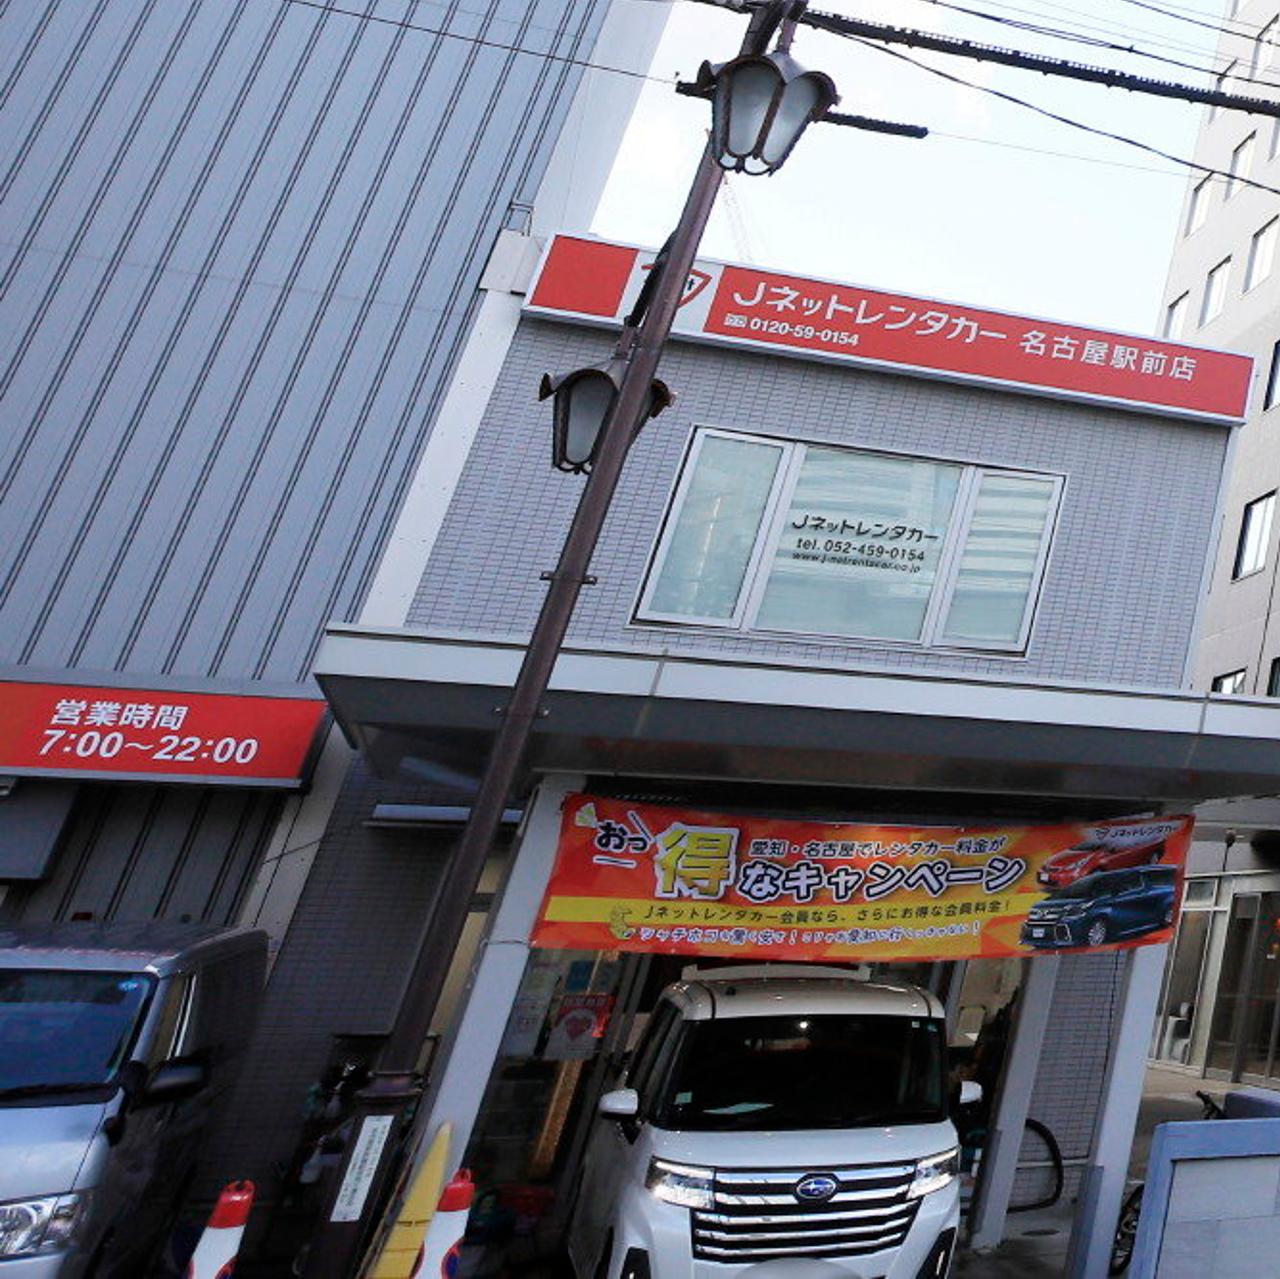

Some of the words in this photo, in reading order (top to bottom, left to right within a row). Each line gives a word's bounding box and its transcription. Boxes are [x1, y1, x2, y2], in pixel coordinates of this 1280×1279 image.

[732, 282, 1008, 344] Jネットレンタカー
[1019, 330, 1198, 381] 名古屋駅前店
[750, 318, 860, 347] 0120-59-0154
[792, 514, 939, 543] Jネットレンタカー
[823, 539, 925, 562] 052-459-0154
[51, 699, 189, 730] 営業時間
